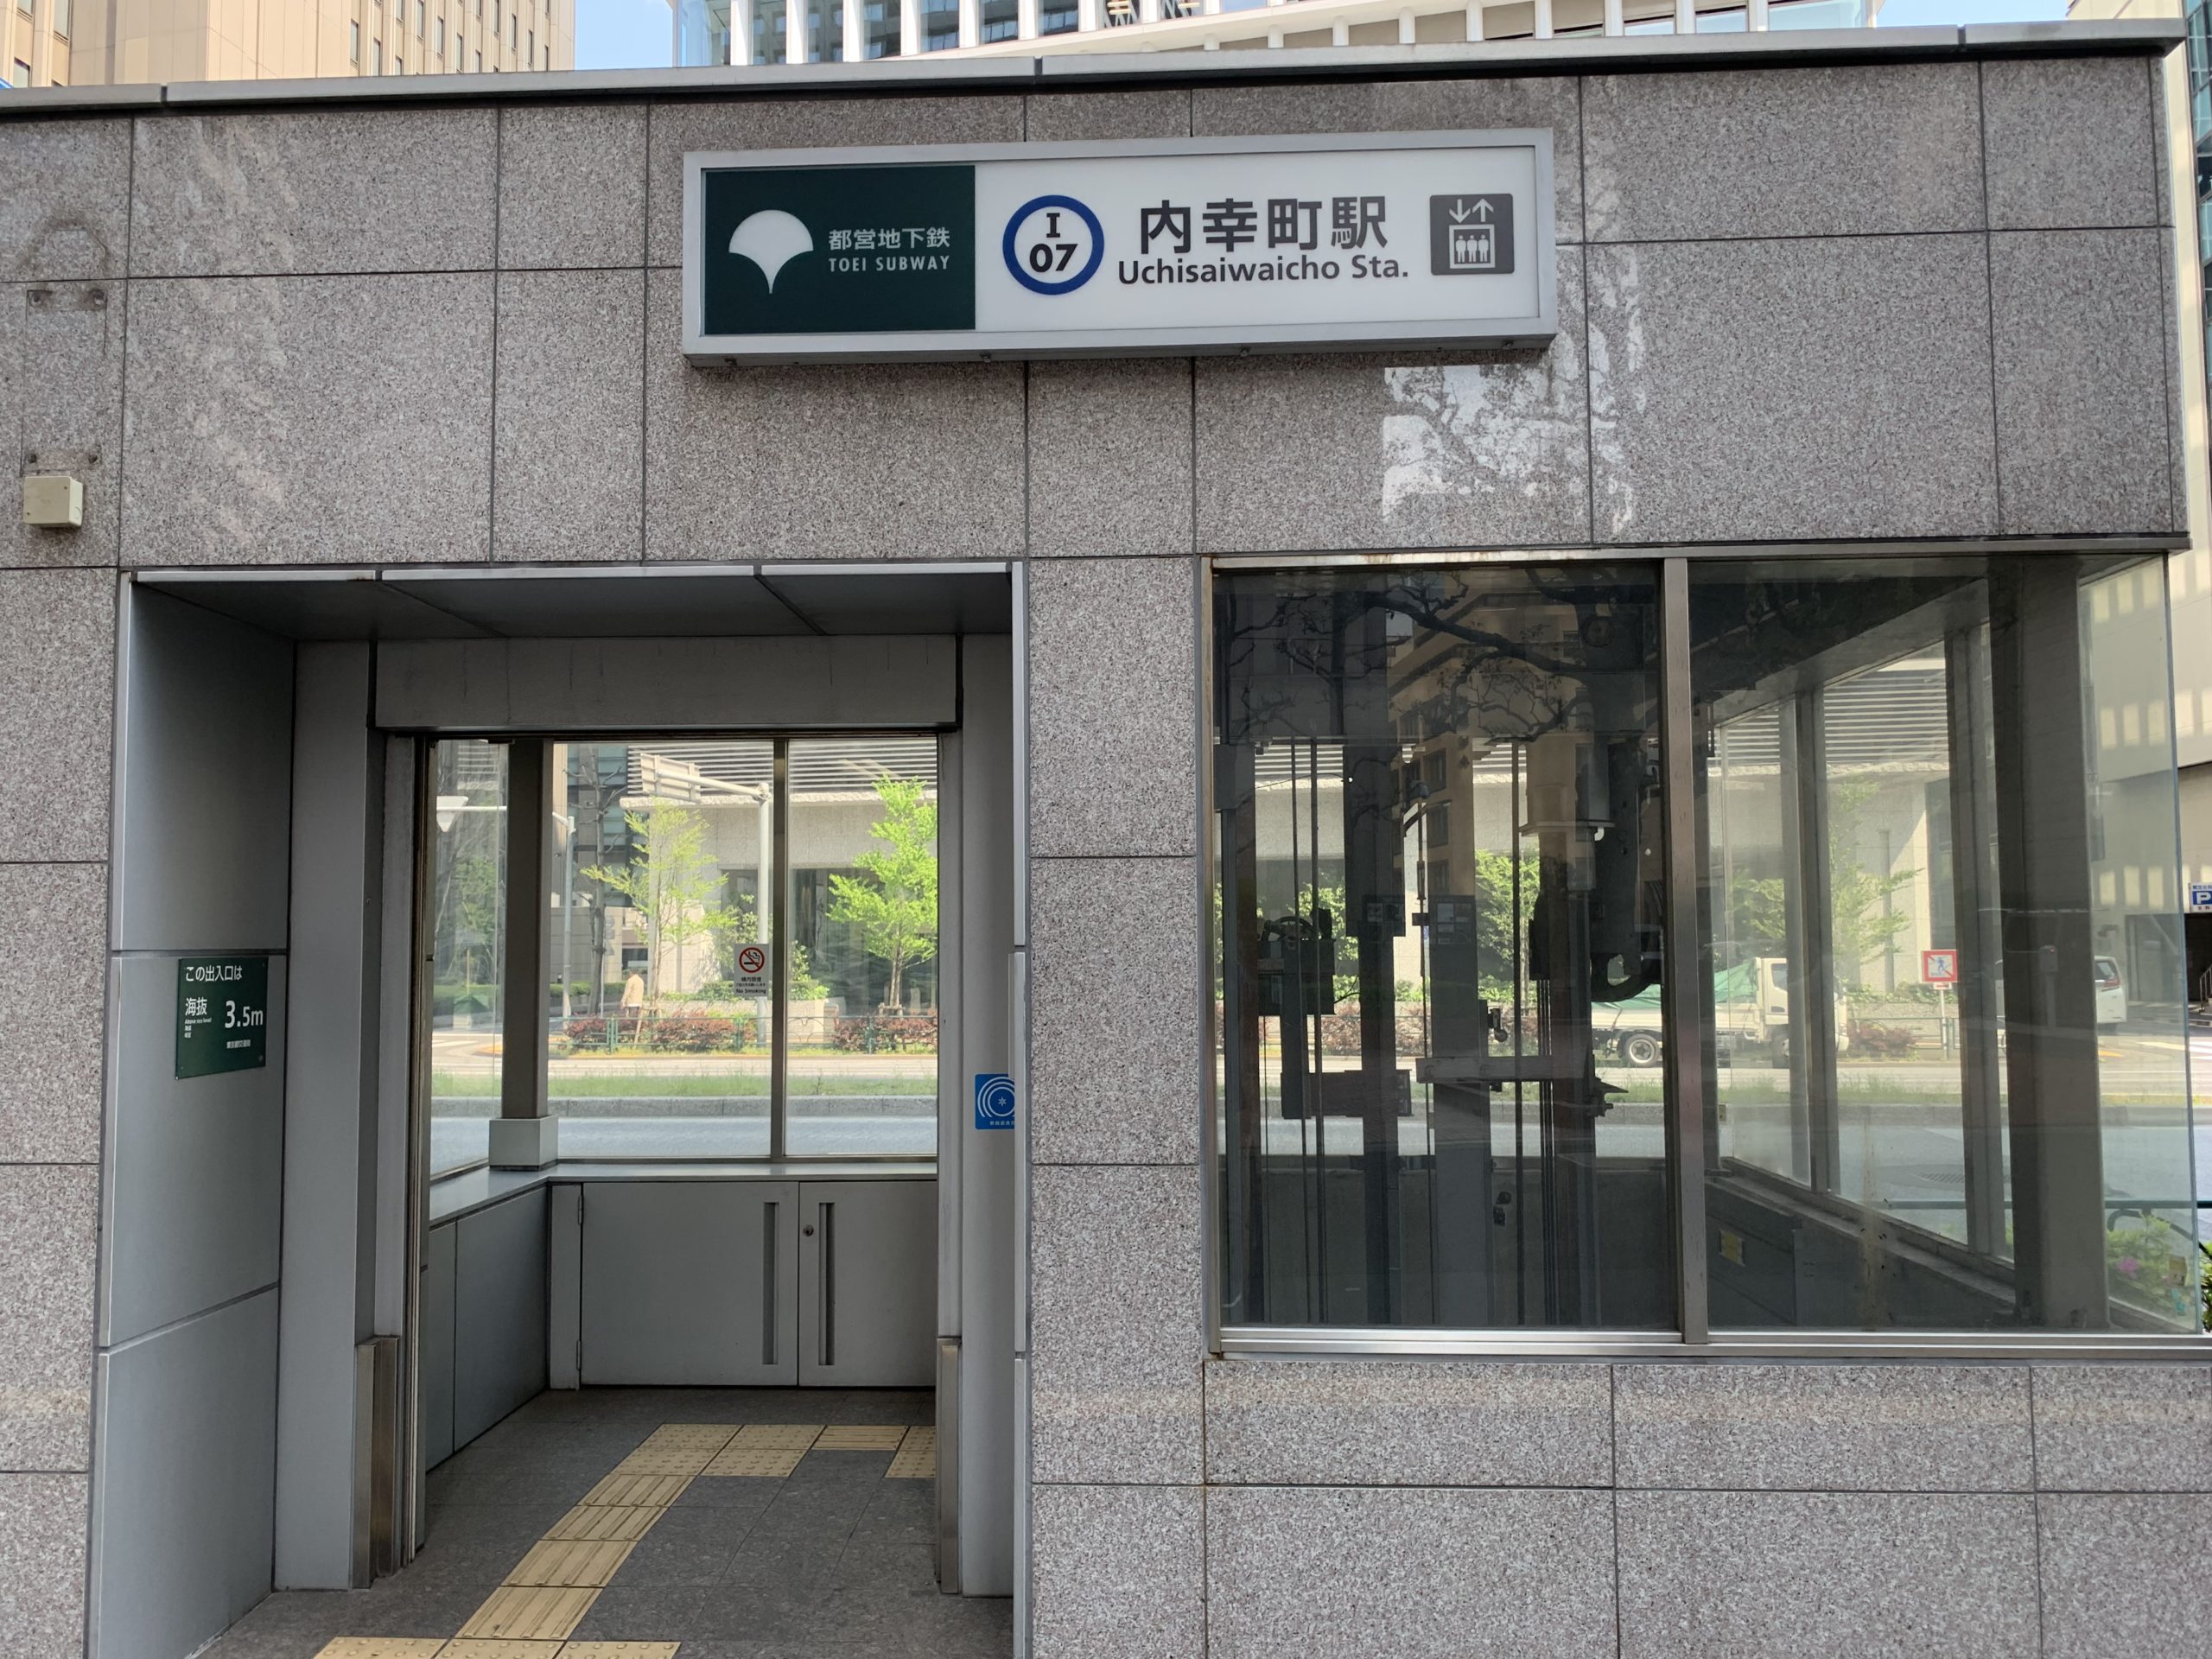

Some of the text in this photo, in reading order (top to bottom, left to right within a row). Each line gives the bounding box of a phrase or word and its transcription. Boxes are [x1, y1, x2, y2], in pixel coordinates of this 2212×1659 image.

[828, 226, 950, 251] 都営地下鉄
[1046, 212, 1061, 238] I
[1140, 195, 1389, 255] 内幸町駅
[828, 255, 950, 272] TOEI SUBWAY
[1028, 243, 1079, 273] 07
[1118, 254, 1409, 285] Uchisaiwaicho Sta.
[186, 965, 243, 982] この出入口は
[185, 997, 264, 1028] 海抜 3.5m
